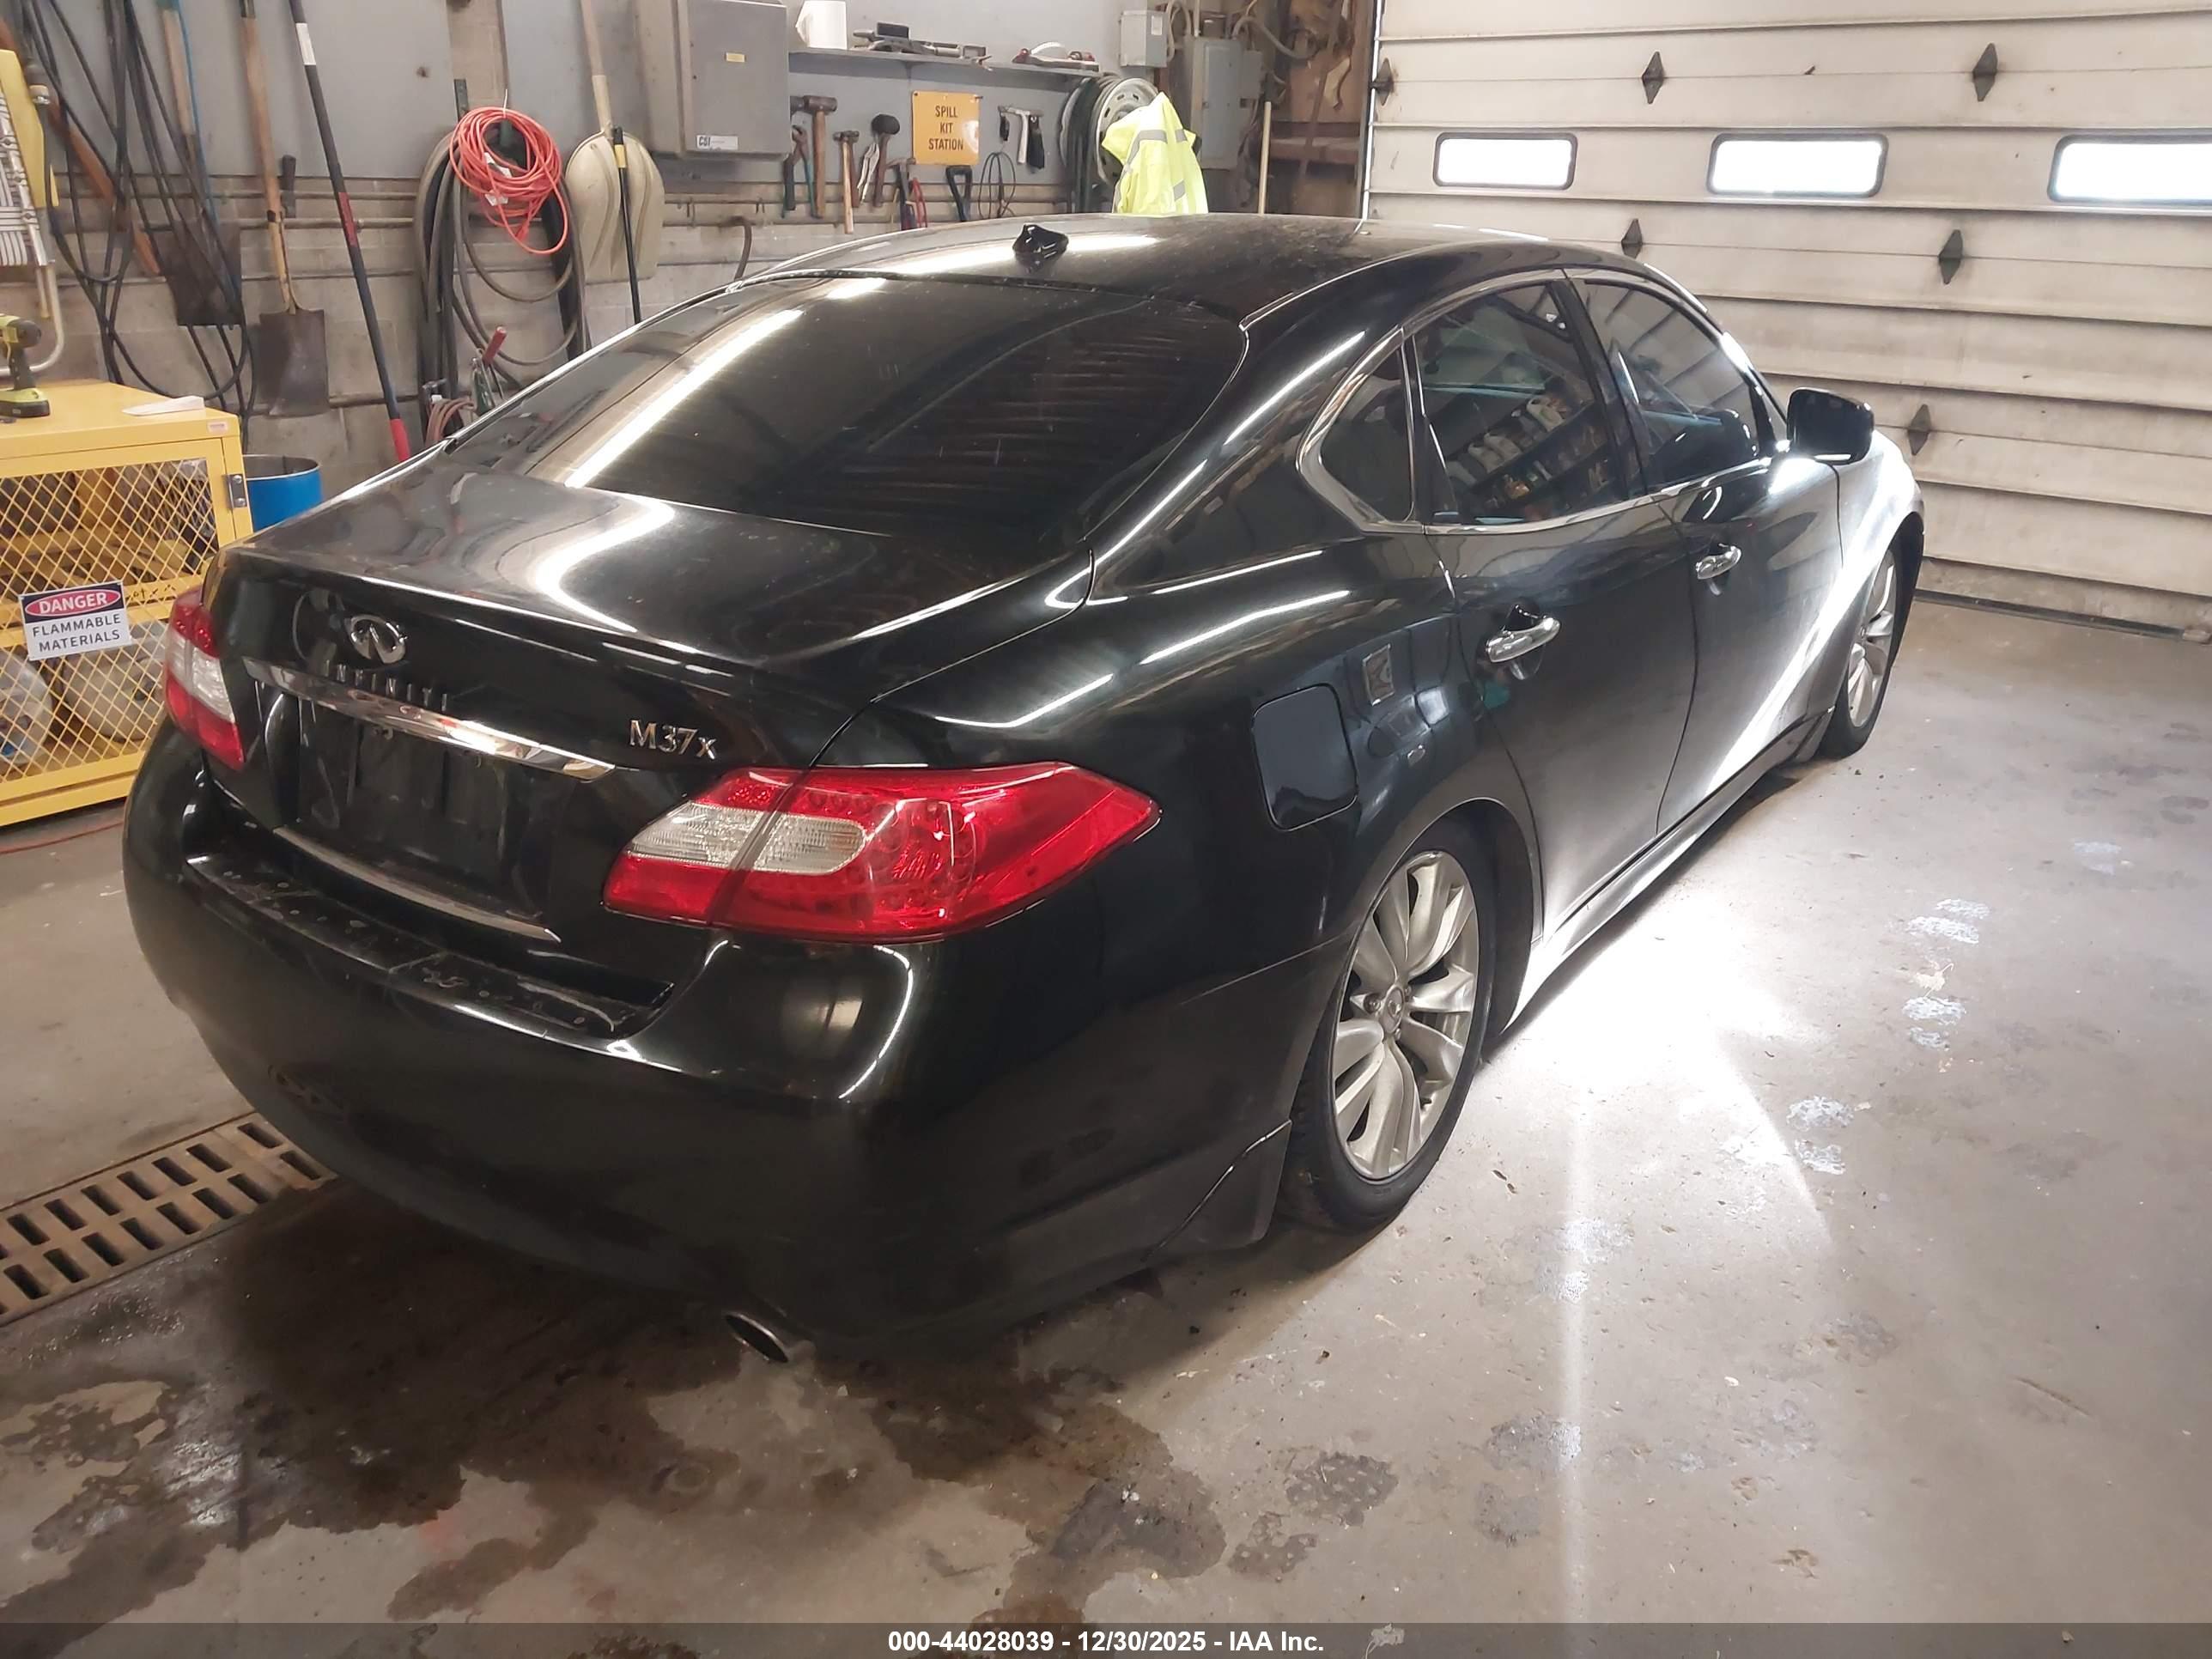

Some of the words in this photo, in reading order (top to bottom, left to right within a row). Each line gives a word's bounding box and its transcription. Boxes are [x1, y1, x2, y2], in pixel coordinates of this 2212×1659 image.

[935, 106, 957, 118] SPILL
[940, 122, 953, 134] KIT
[928, 138, 963, 151] STATION
[39, 592, 107, 614] DANGER
[33, 613, 121, 637] FLAMMABLE
[39, 629, 120, 653] MATERIALS
